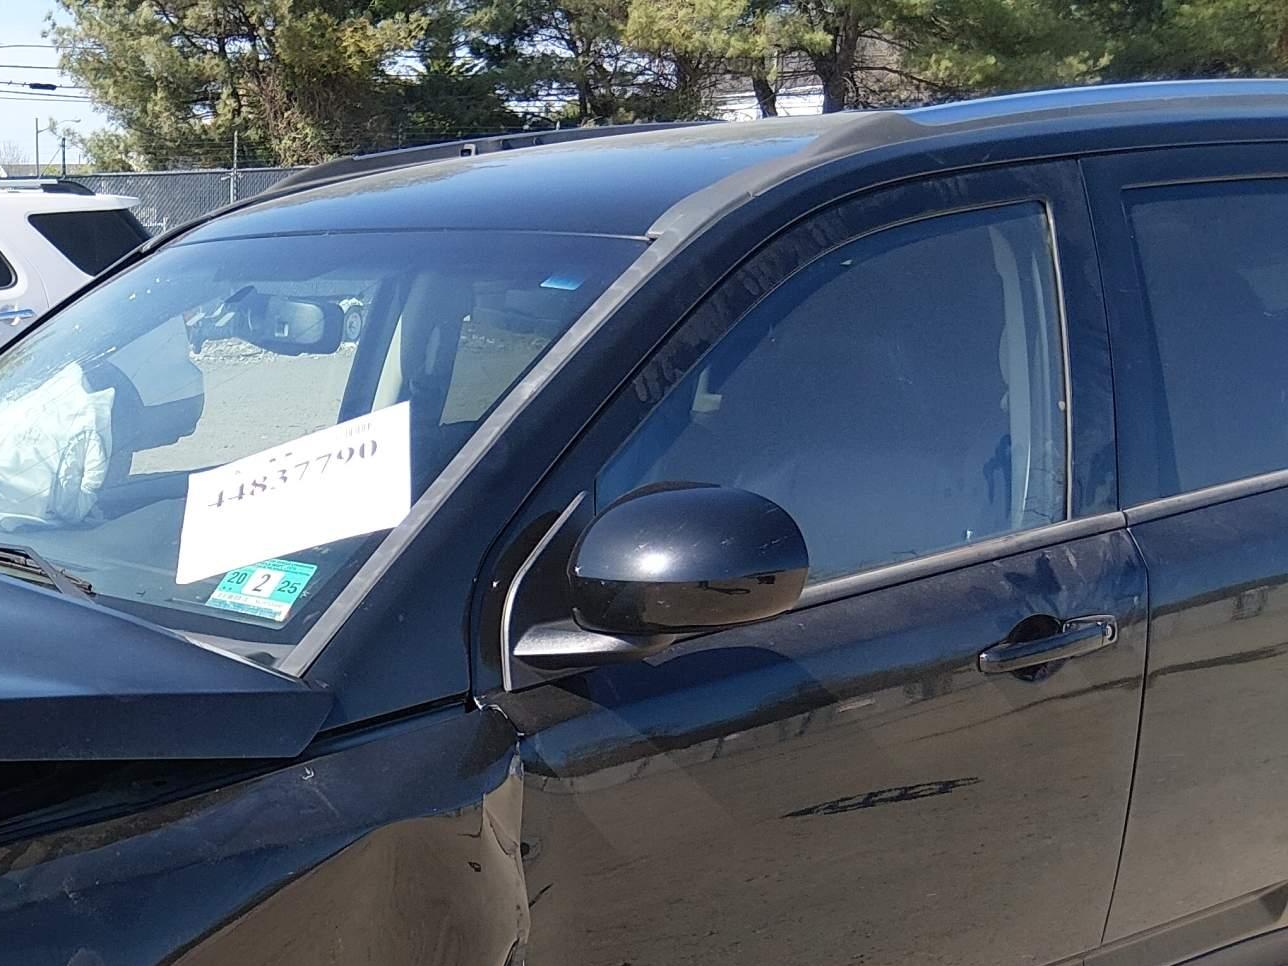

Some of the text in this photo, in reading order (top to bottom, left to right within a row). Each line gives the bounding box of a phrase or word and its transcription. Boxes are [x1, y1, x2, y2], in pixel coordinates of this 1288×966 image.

[228, 571, 301, 594] 20 2 25
